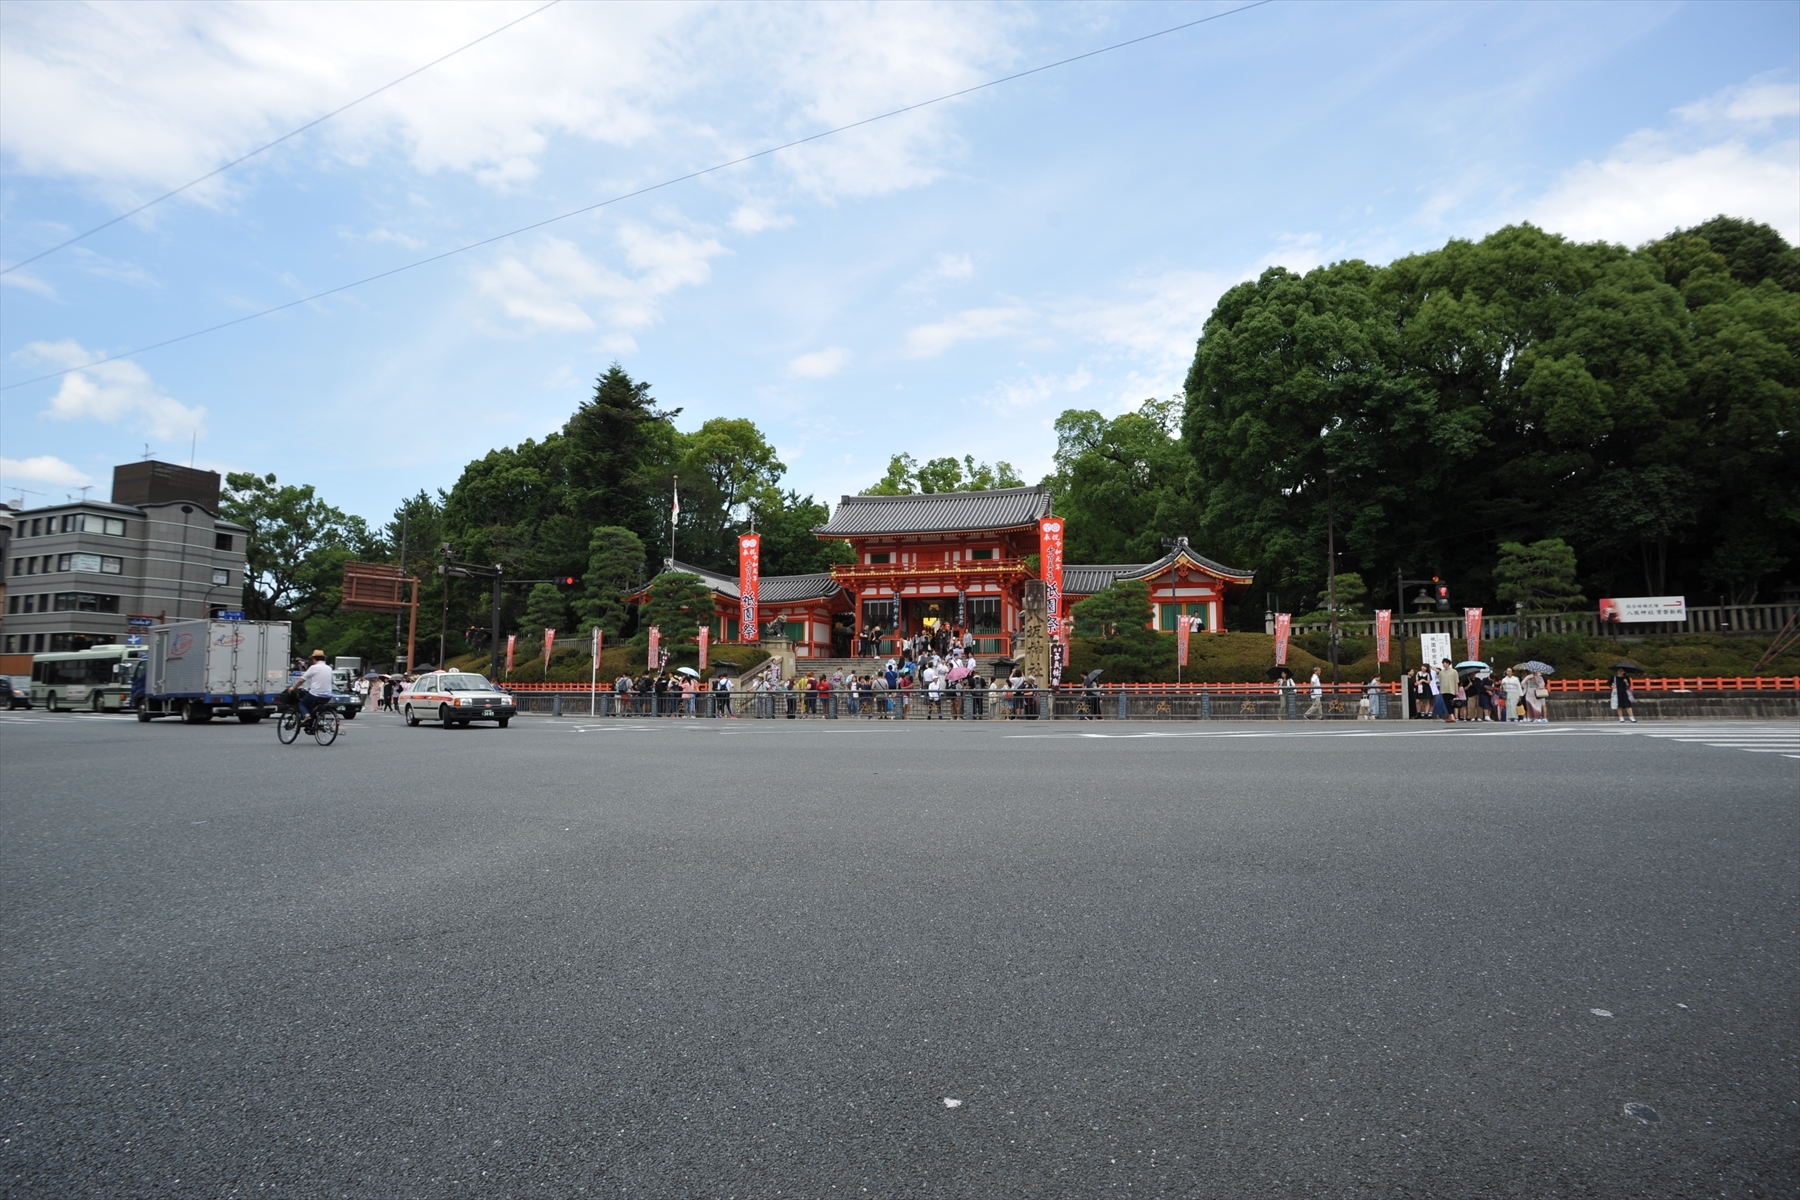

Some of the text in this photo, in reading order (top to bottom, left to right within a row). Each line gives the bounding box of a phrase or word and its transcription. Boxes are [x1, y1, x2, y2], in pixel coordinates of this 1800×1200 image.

[741, 591, 758, 639] 祇園祭
[1026, 613, 1044, 677] 八坂神社
